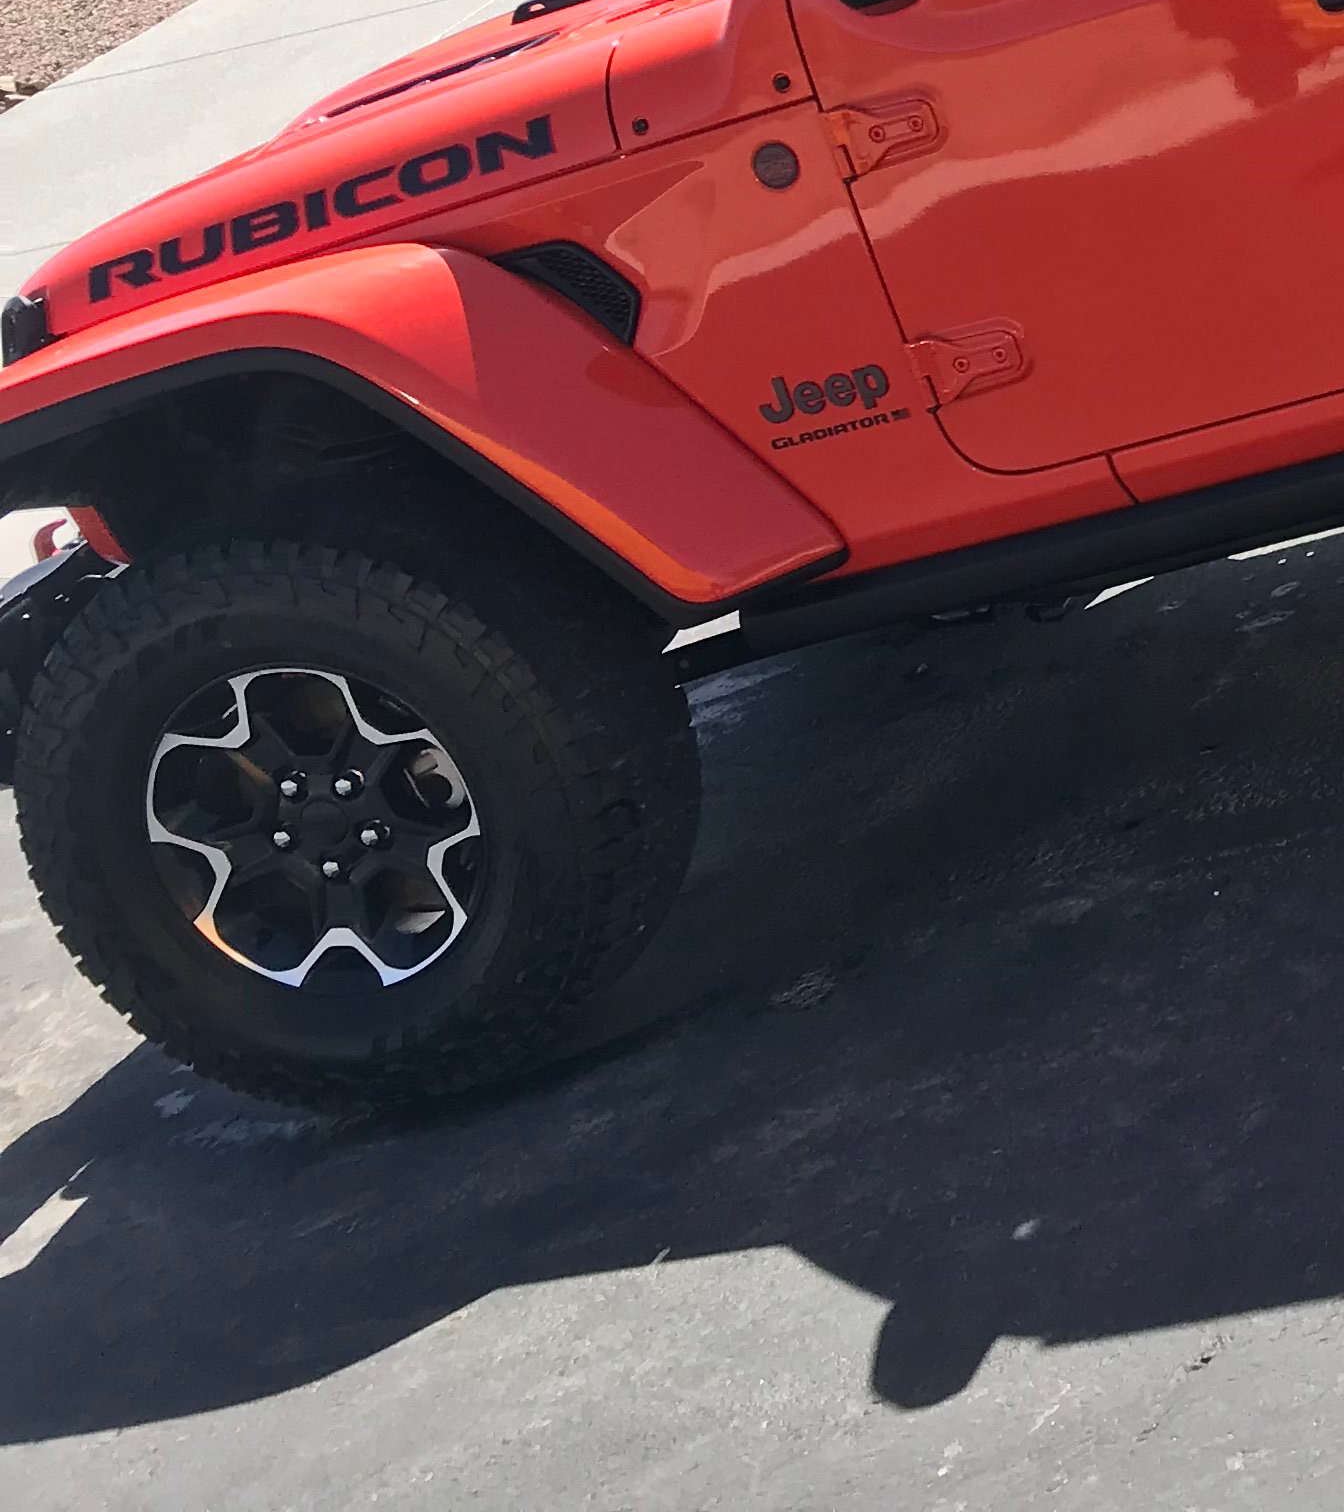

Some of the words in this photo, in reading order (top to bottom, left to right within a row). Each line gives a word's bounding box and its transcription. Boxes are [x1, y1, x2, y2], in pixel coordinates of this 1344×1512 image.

[87, 114, 557, 303] RUBICON
[758, 363, 890, 424] Jeep
[770, 412, 890, 450] GLADIATOR
